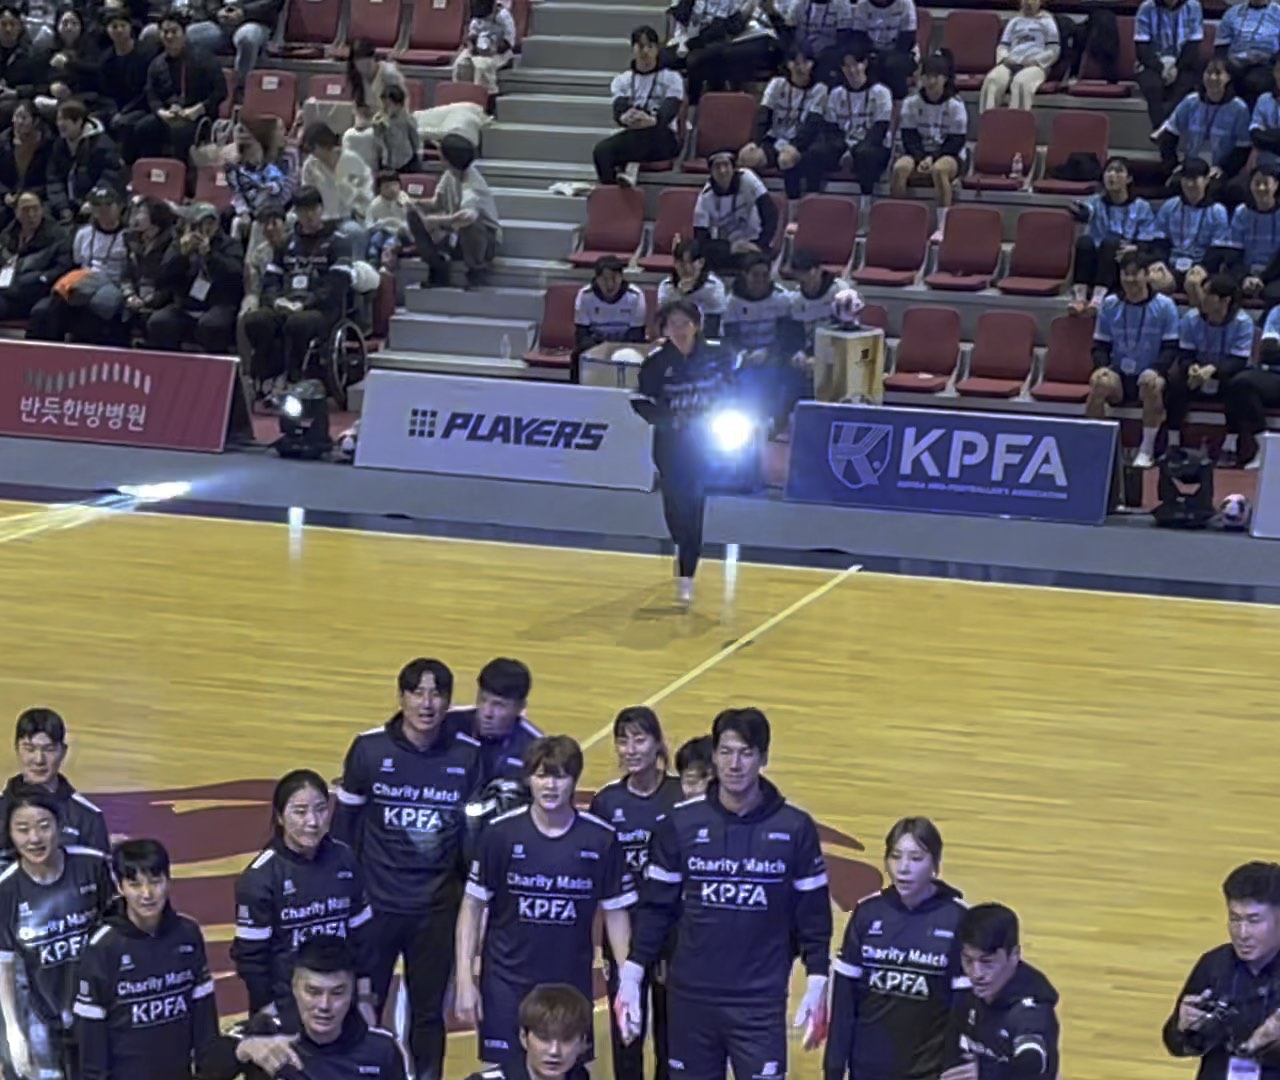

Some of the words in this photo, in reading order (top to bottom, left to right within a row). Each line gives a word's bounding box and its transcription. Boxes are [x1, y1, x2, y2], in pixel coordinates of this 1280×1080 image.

[20, 396, 147, 432] 반듯한방병원
[440, 412, 609, 451] PLAYERS
[899, 427, 1068, 486] KPFA
[384, 807, 442, 829] KPFA
[688, 856, 739, 874] Charity
[742, 857, 786, 873] Match
[701, 882, 768, 905] KPFA
[518, 897, 577, 919] KPFA
[908, 948, 948, 967] Match
[870, 969, 929, 996] KPFA
[132, 995, 187, 1023] KPFA
